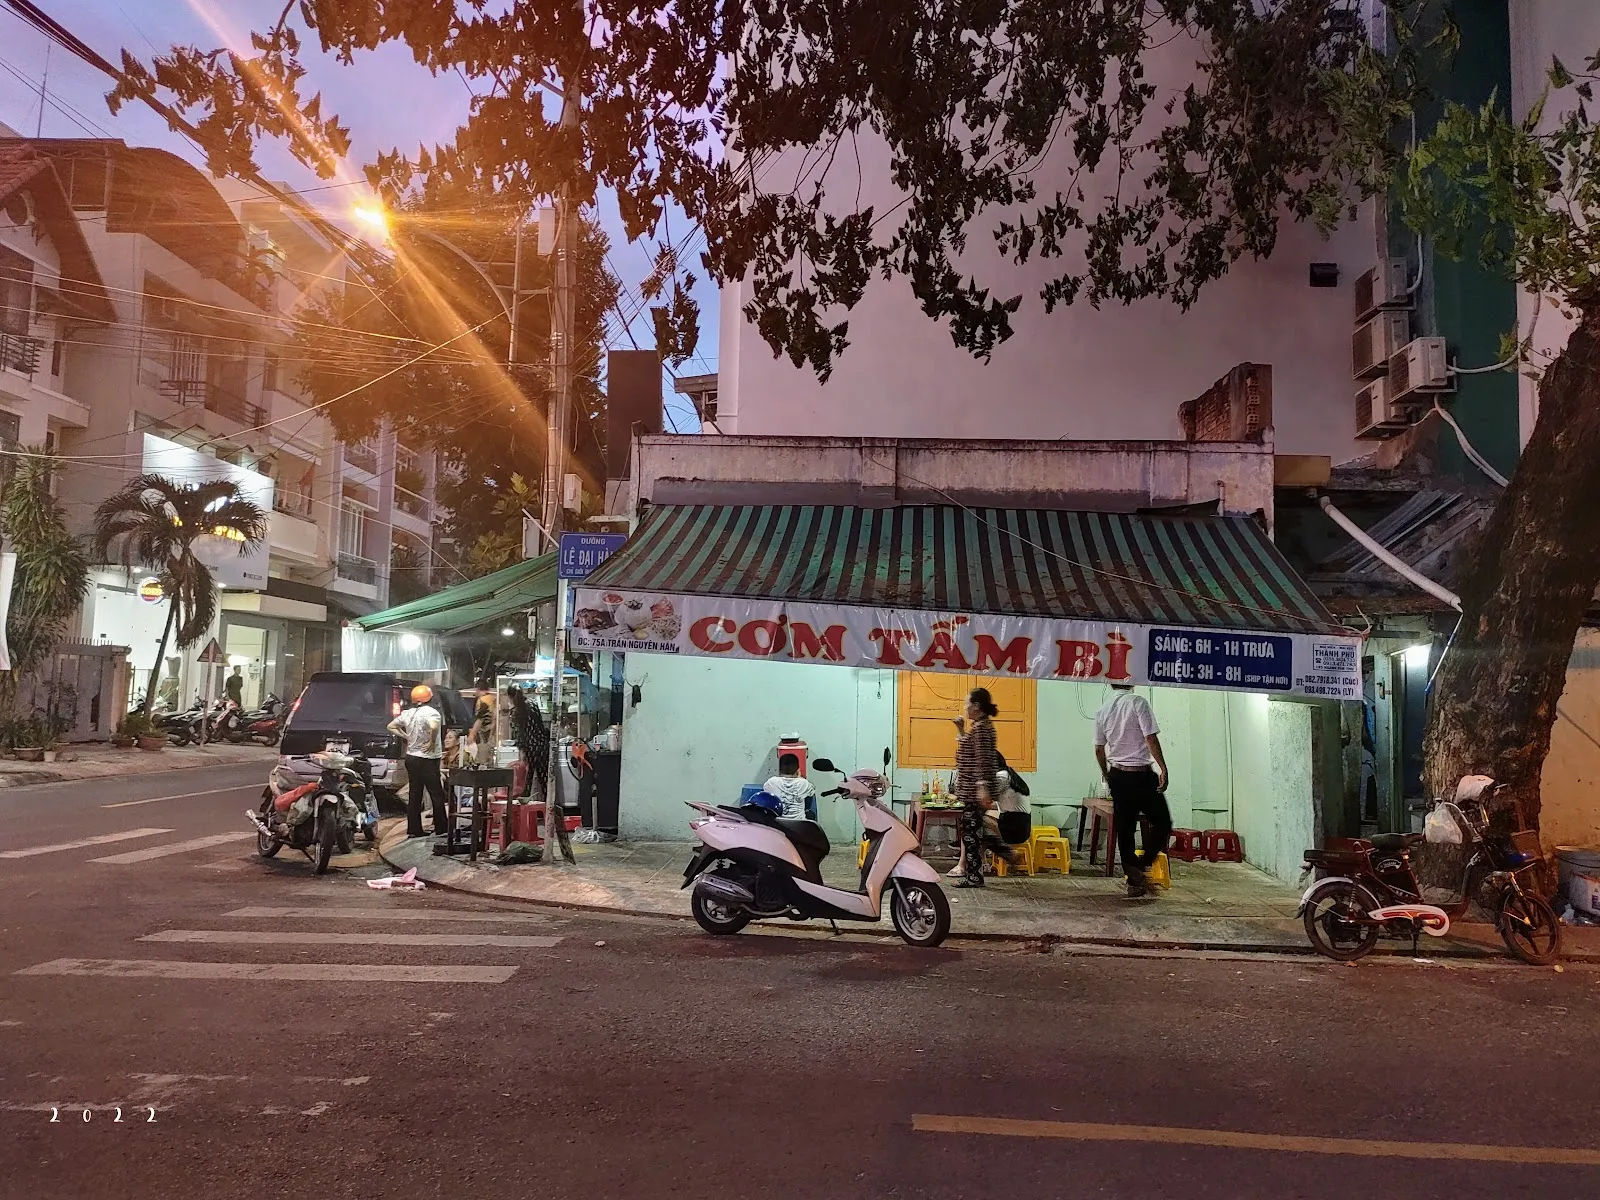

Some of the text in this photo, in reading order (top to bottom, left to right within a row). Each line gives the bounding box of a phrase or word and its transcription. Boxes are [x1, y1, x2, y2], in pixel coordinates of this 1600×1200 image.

[563, 546, 614, 568] LÊ ĐẠI HÀ
[689, 614, 1133, 680] CƠM TẤM BÌ
[1154, 633, 1192, 653] SÁNG:
[1195, 637, 1212, 654] 6H
[1224, 640, 1240, 656] 1H
[1242, 640, 1275, 659] TRƯA
[1154, 657, 1194, 679] CHIỀU:
[1197, 663, 1214, 680] 3H
[1225, 665, 1241, 682] 8H
[1244, 674, 1261, 684] (SHIP
